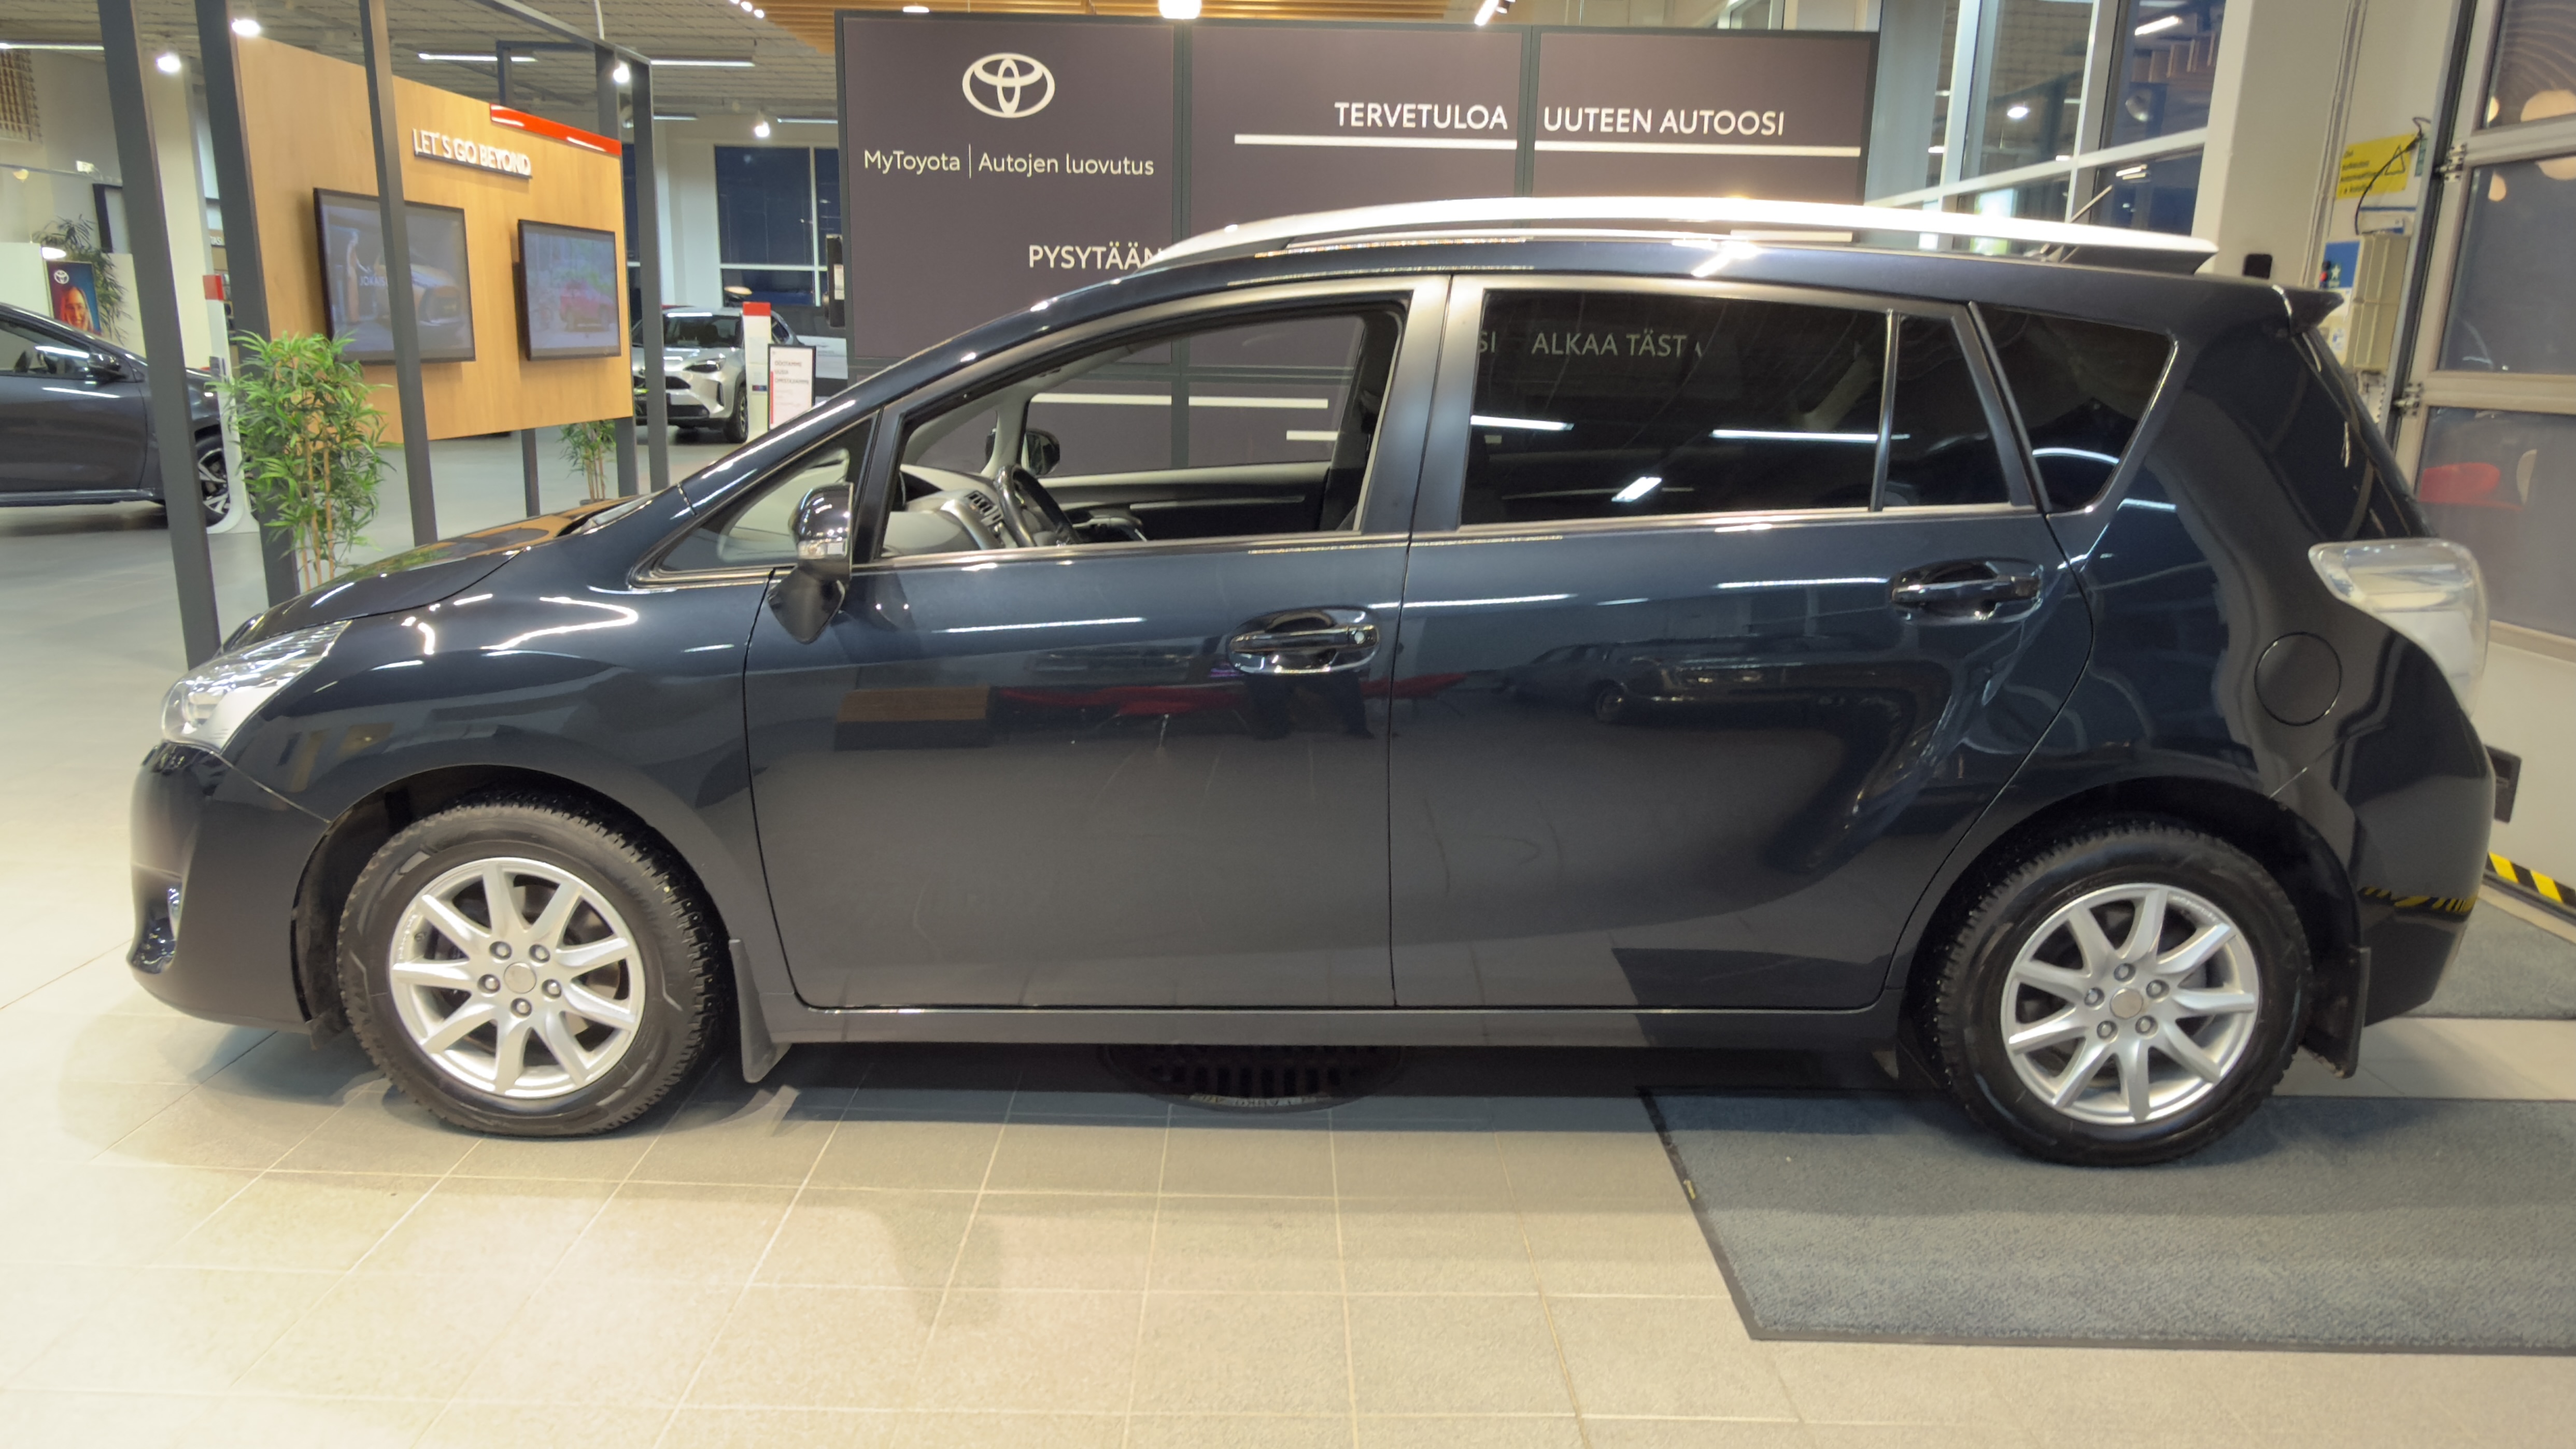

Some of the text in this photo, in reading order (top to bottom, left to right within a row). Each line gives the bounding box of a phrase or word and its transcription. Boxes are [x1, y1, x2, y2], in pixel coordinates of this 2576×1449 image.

[1335, 103, 1784, 136] TERVETULOA UUTEEN AUTOOSI
[453, 138, 477, 163] GO
[478, 144, 531, 176] BEYOND
[864, 150, 1154, 177] MyToyota Autojen luovutus
[1531, 332, 1618, 356] ALKAA
